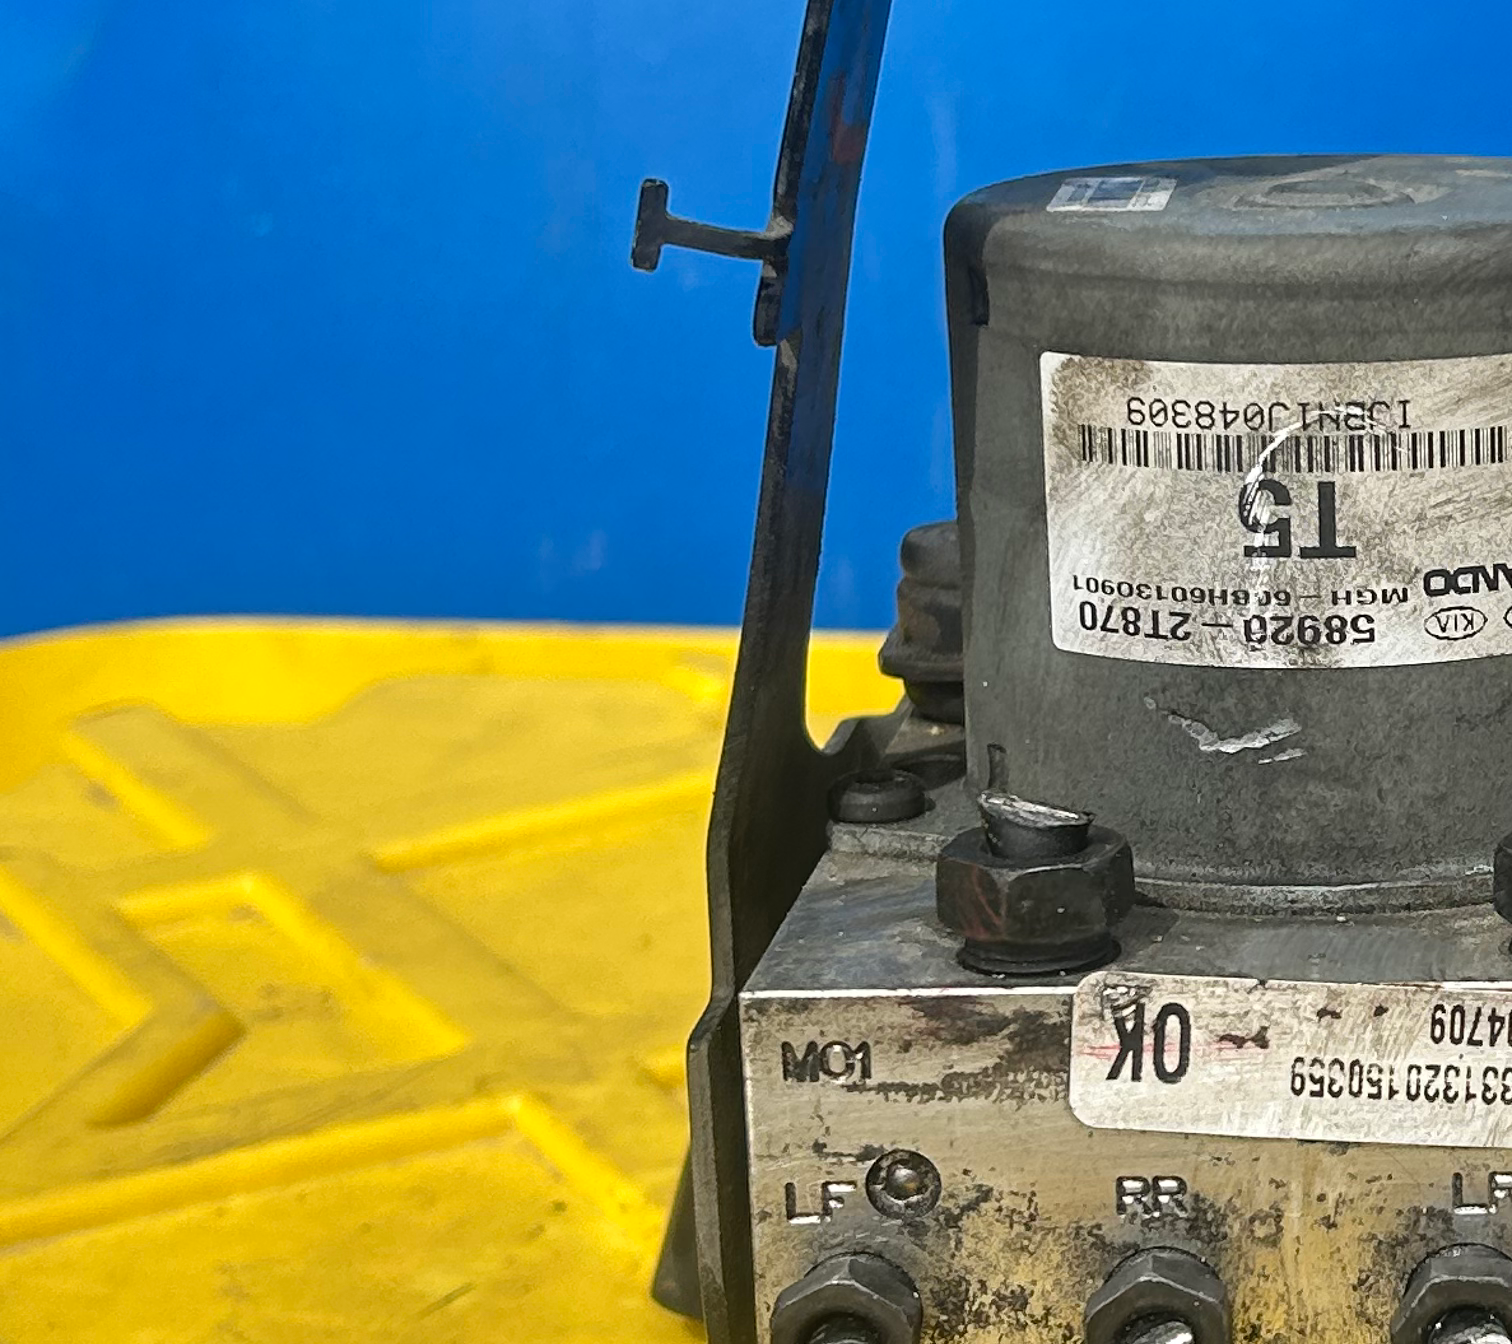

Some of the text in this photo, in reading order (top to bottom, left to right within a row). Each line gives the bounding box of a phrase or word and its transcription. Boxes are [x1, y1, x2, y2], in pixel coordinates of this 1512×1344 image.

[1239, 478, 1357, 559] T5
[1331, 587, 1409, 607] MGH
[1078, 600, 1192, 641] 2T870
[1244, 613, 1376, 646] 58920
[1105, 1002, 1191, 1084] OK
[785, 1181, 857, 1225] LF
[1115, 1175, 1188, 1218] RR
